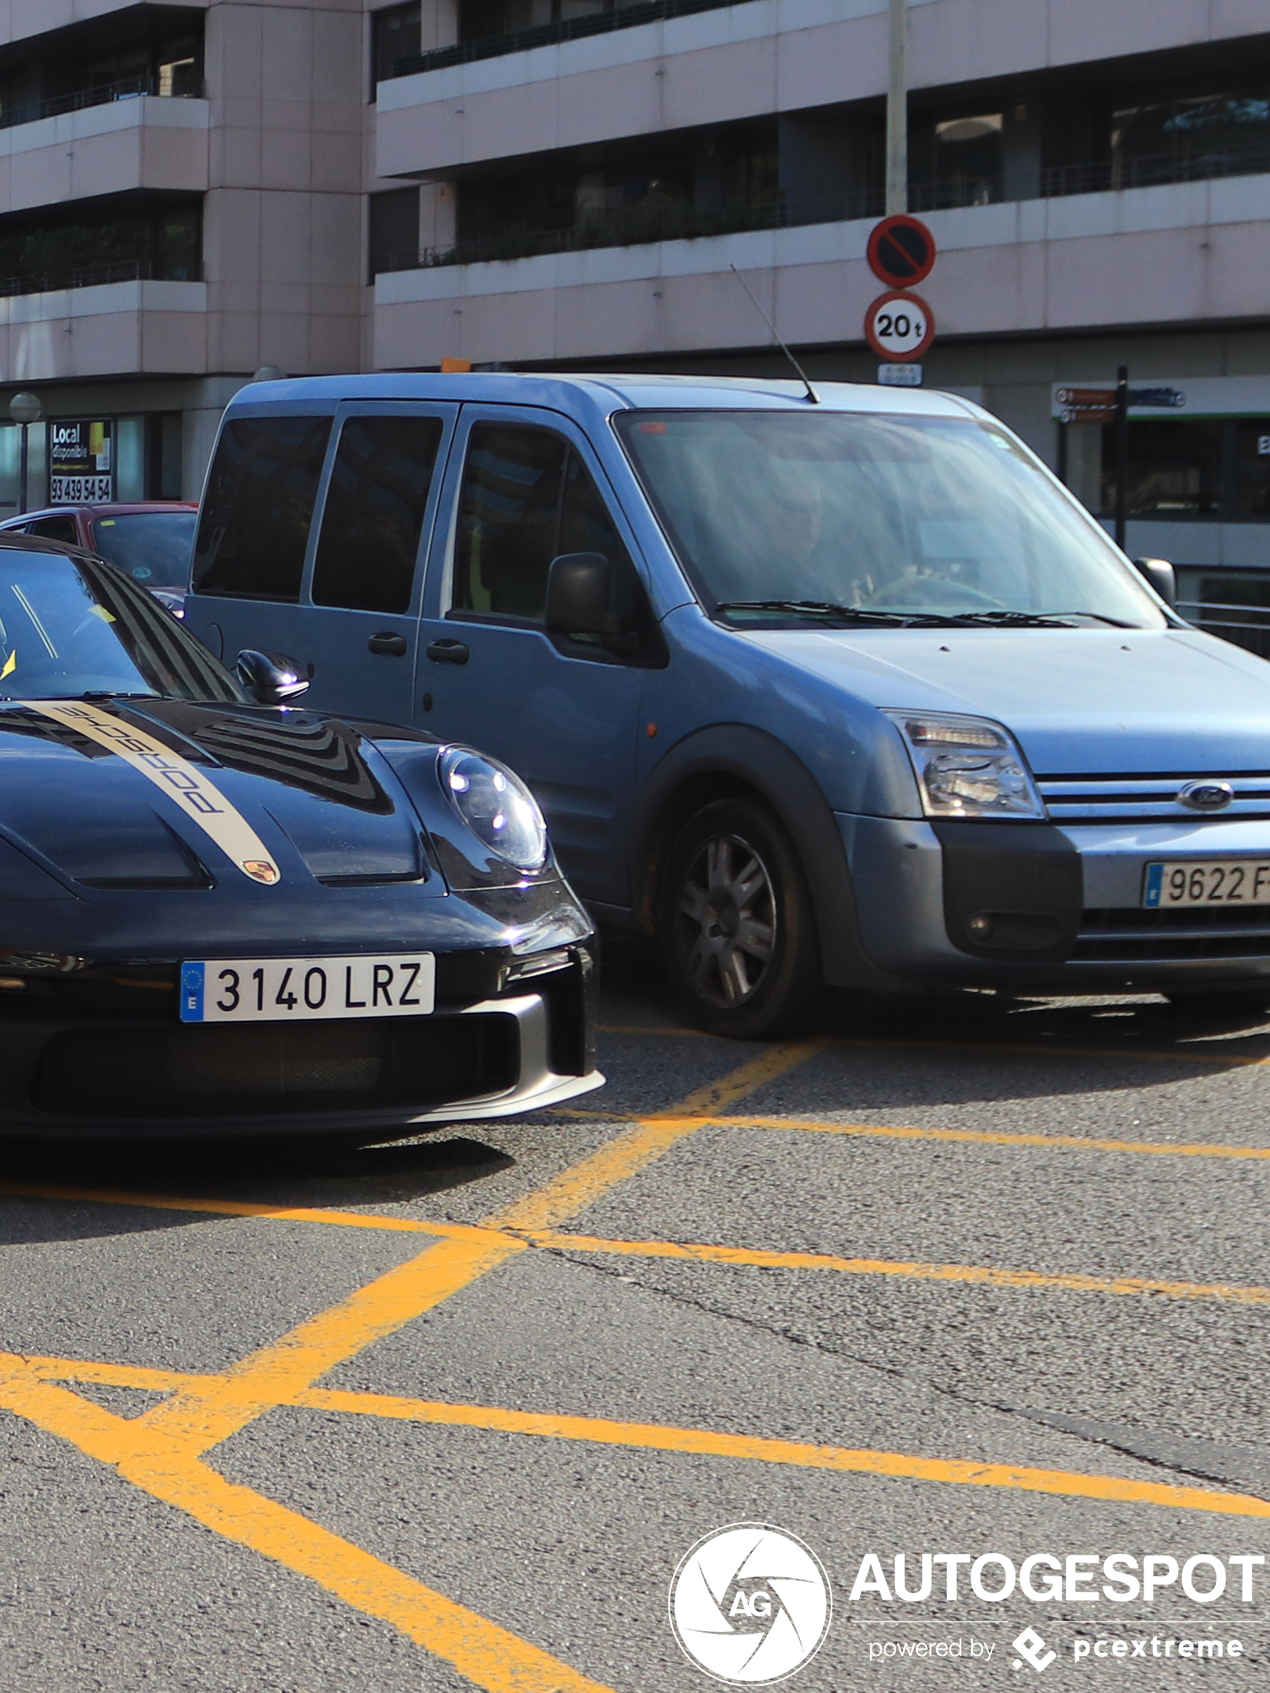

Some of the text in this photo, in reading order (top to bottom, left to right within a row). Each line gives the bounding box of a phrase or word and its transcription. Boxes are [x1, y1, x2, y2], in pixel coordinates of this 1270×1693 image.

[878, 314, 922, 337] 20 t
[53, 424, 80, 443] Local
[53, 444, 87, 460] disponible
[52, 479, 110, 500] 93 439 54 54
[52, 706, 225, 814] PORSCHE
[1169, 866, 1244, 901] 9622
[216, 962, 421, 1012] 3140 LRZ
[188, 997, 196, 1009] E
